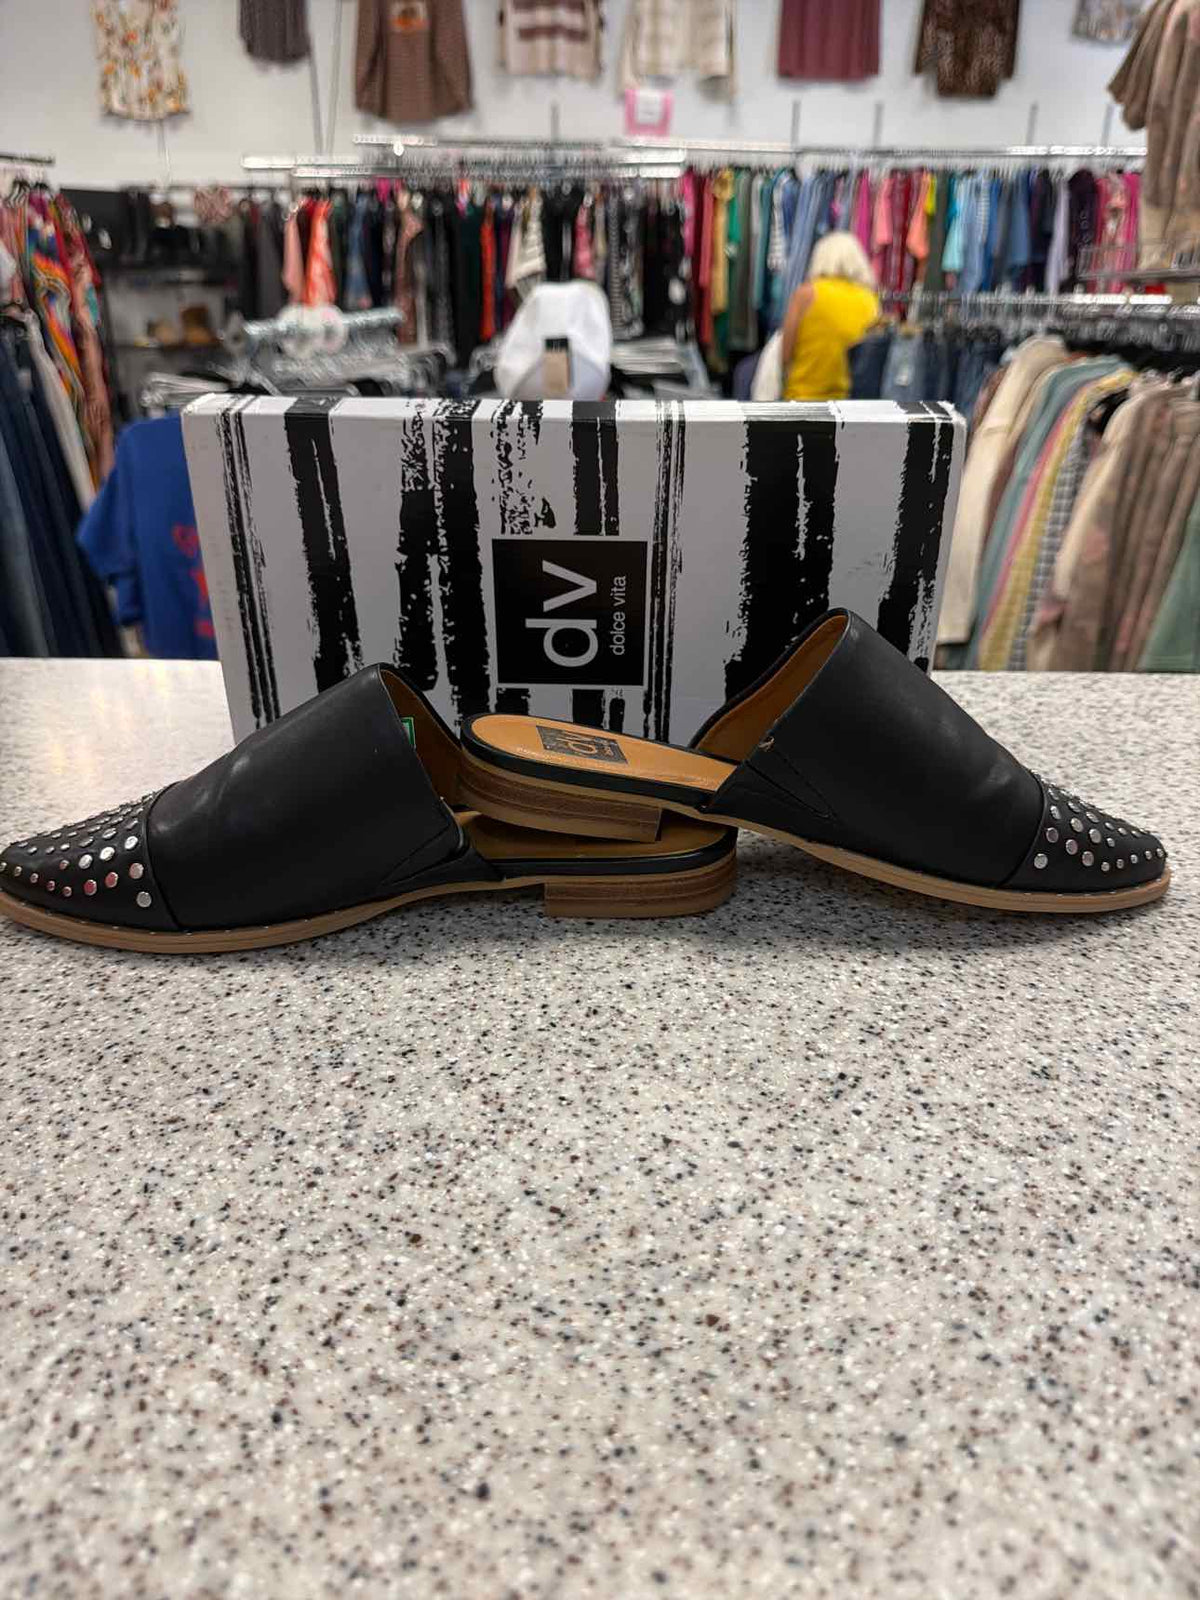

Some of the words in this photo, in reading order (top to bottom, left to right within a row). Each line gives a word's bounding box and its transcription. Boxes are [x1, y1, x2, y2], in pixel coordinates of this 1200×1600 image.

[610, 575, 627, 607] vita
[525, 560, 598, 667] dv
[610, 611, 626, 655] dolce
